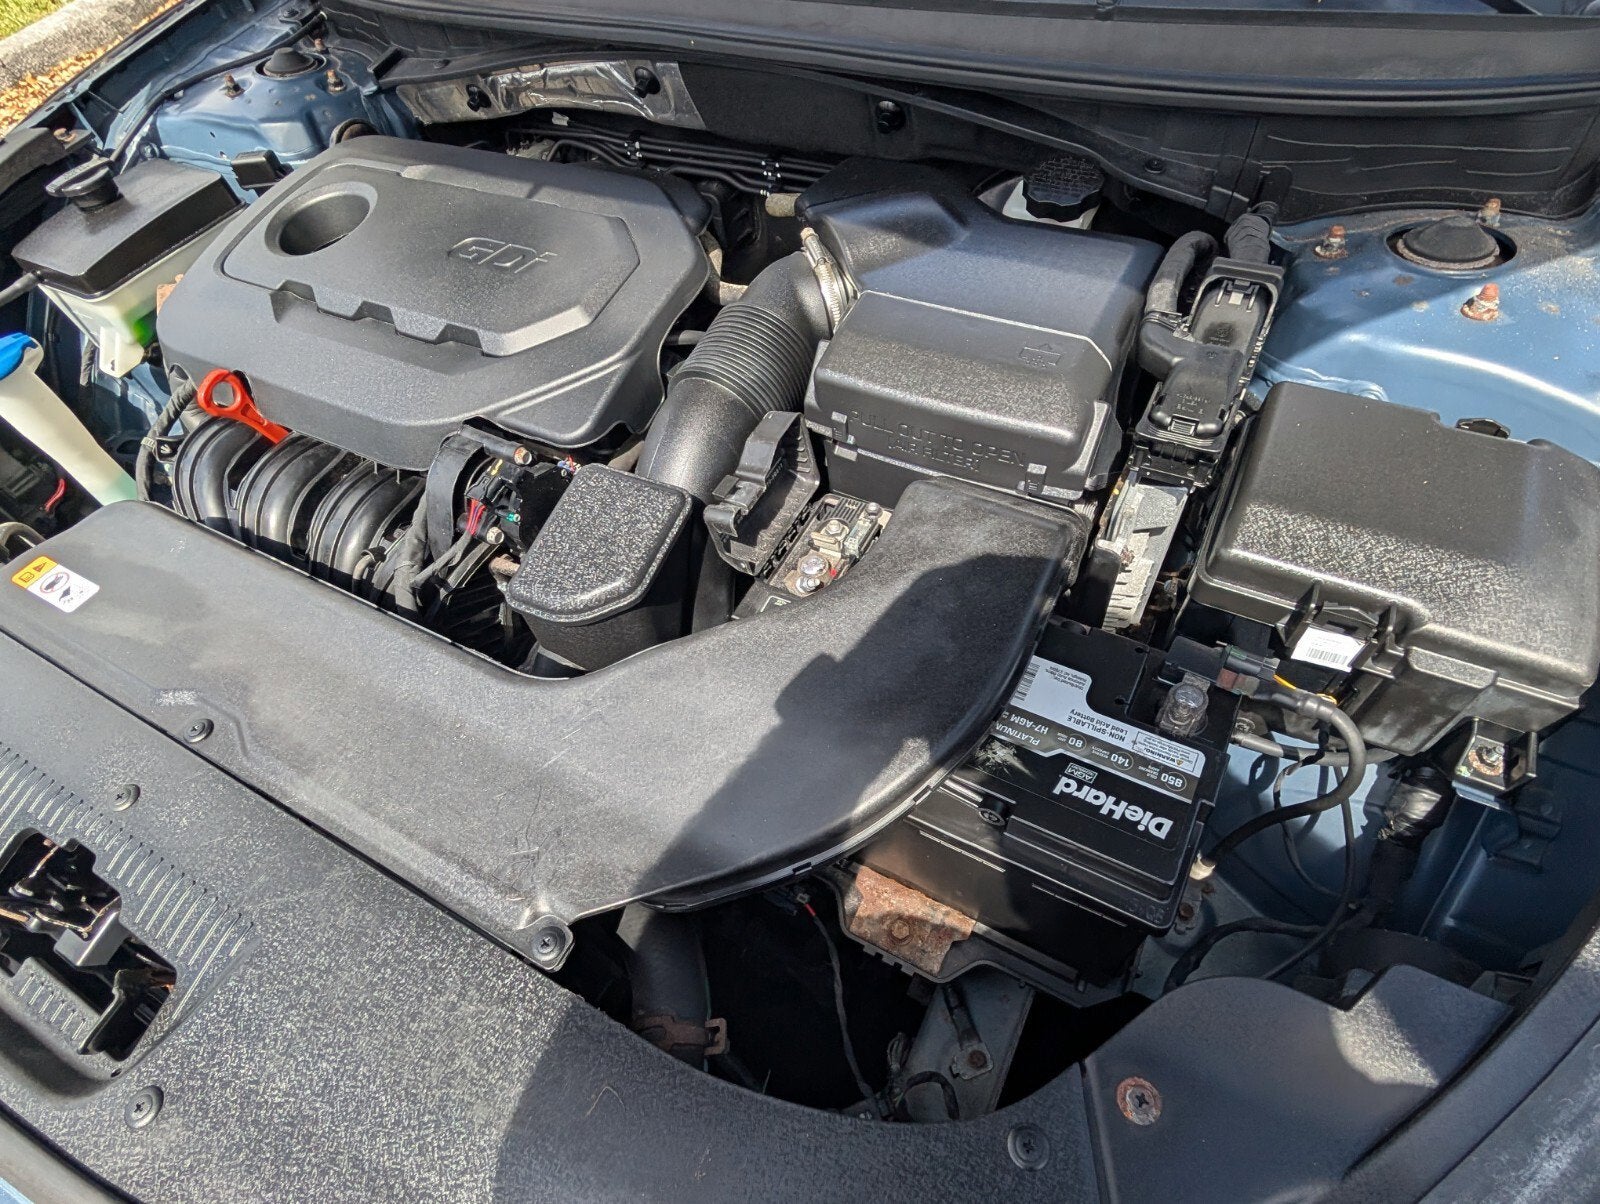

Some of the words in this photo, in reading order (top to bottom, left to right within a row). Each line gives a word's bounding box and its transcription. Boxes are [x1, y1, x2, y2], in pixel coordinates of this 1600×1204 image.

[847, 409, 896, 433] PULL
[896, 422, 936, 444] OUT
[937, 433, 966, 452] TO
[971, 441, 1026, 467] OPEN
[1069, 708, 1095, 723] Battery
[1010, 713, 1048, 734] H7-AGM
[1066, 715, 1125, 742] NON-SPILLABLE
[1095, 719, 1110, 728] Acid
[1110, 724, 1128, 735] Lead
[1067, 735, 1083, 748] 80
[1110, 752, 1130, 767] 140
[1067, 767, 1092, 781] AGM
[1160, 772, 1183, 787] 850
[1052, 774, 1173, 839] DieHard
